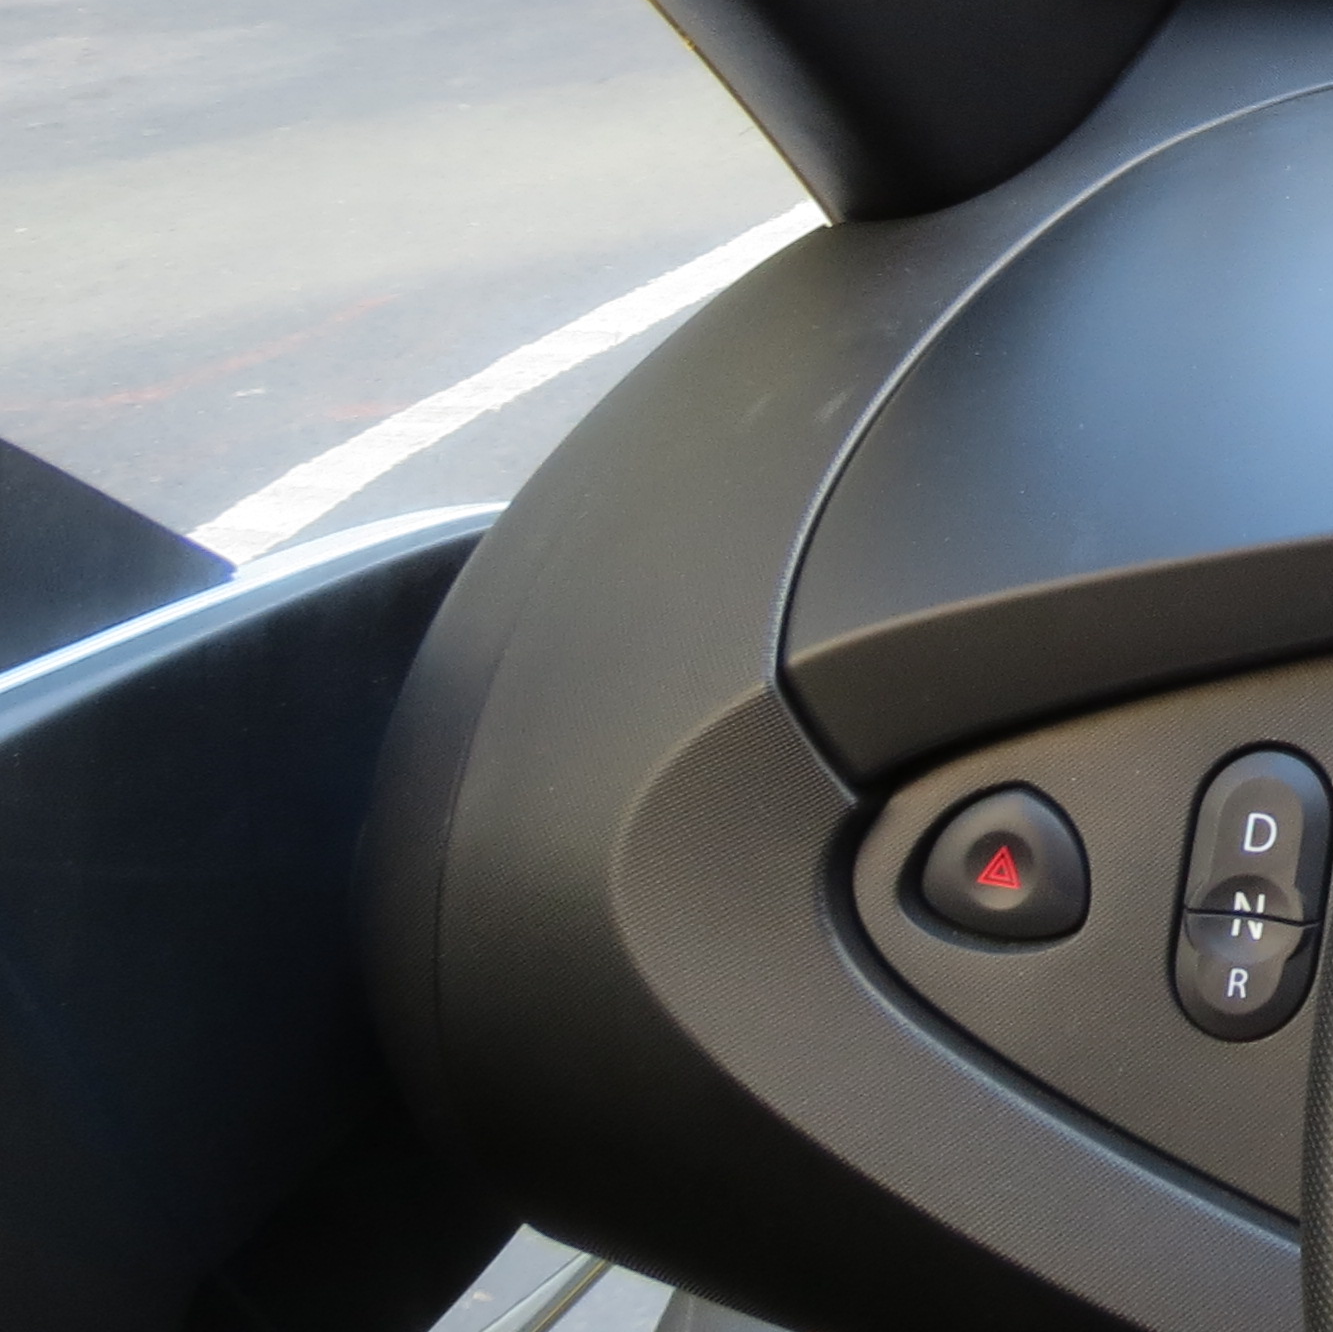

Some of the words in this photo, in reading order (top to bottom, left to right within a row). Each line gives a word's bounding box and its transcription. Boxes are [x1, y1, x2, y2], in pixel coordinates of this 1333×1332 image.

[1243, 811, 1278, 853] D
[1230, 890, 1266, 941] N
[1226, 967, 1249, 999] R
